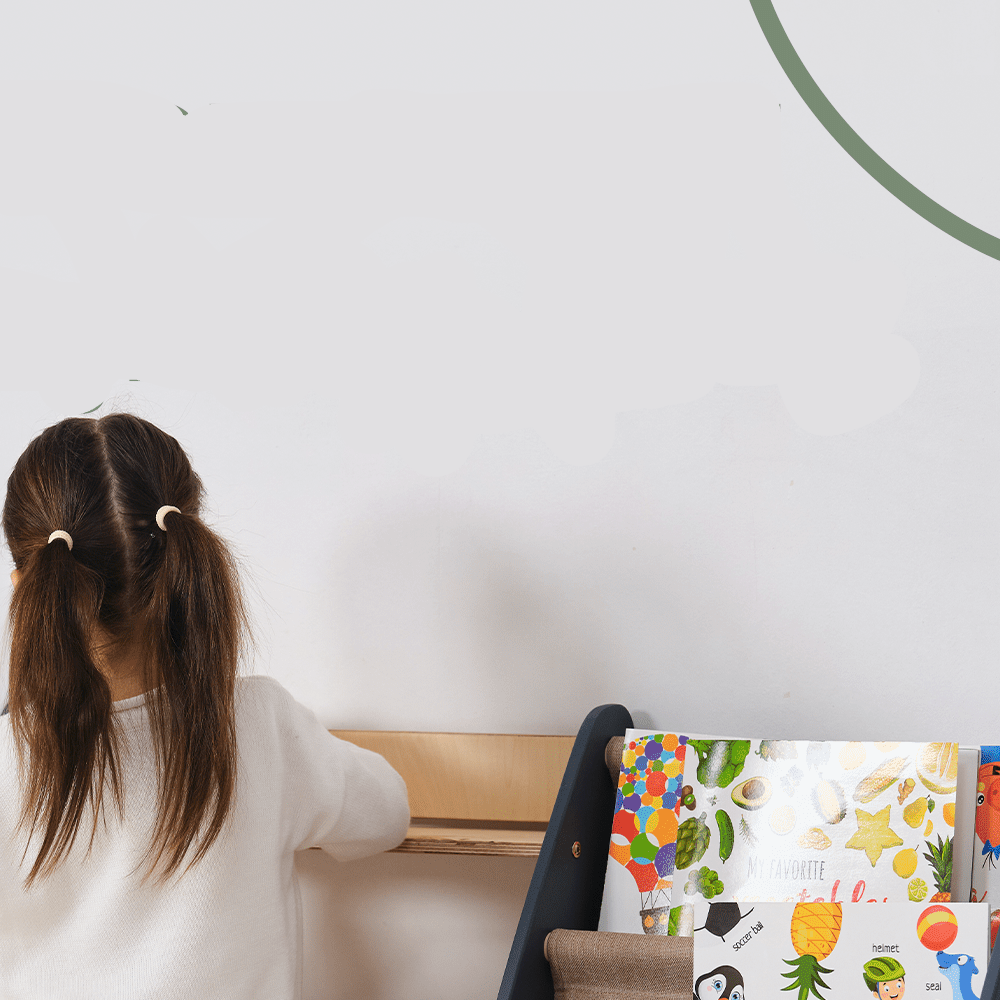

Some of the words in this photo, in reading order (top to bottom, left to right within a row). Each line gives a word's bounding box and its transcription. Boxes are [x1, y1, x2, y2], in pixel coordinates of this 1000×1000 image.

[747, 856, 765, 879] MY
[770, 859, 826, 881] FAVORITE
[732, 930, 753, 952] soccer
[750, 920, 764, 935] ball
[872, 943, 900, 953] helmet
[925, 981, 942, 991] seal
